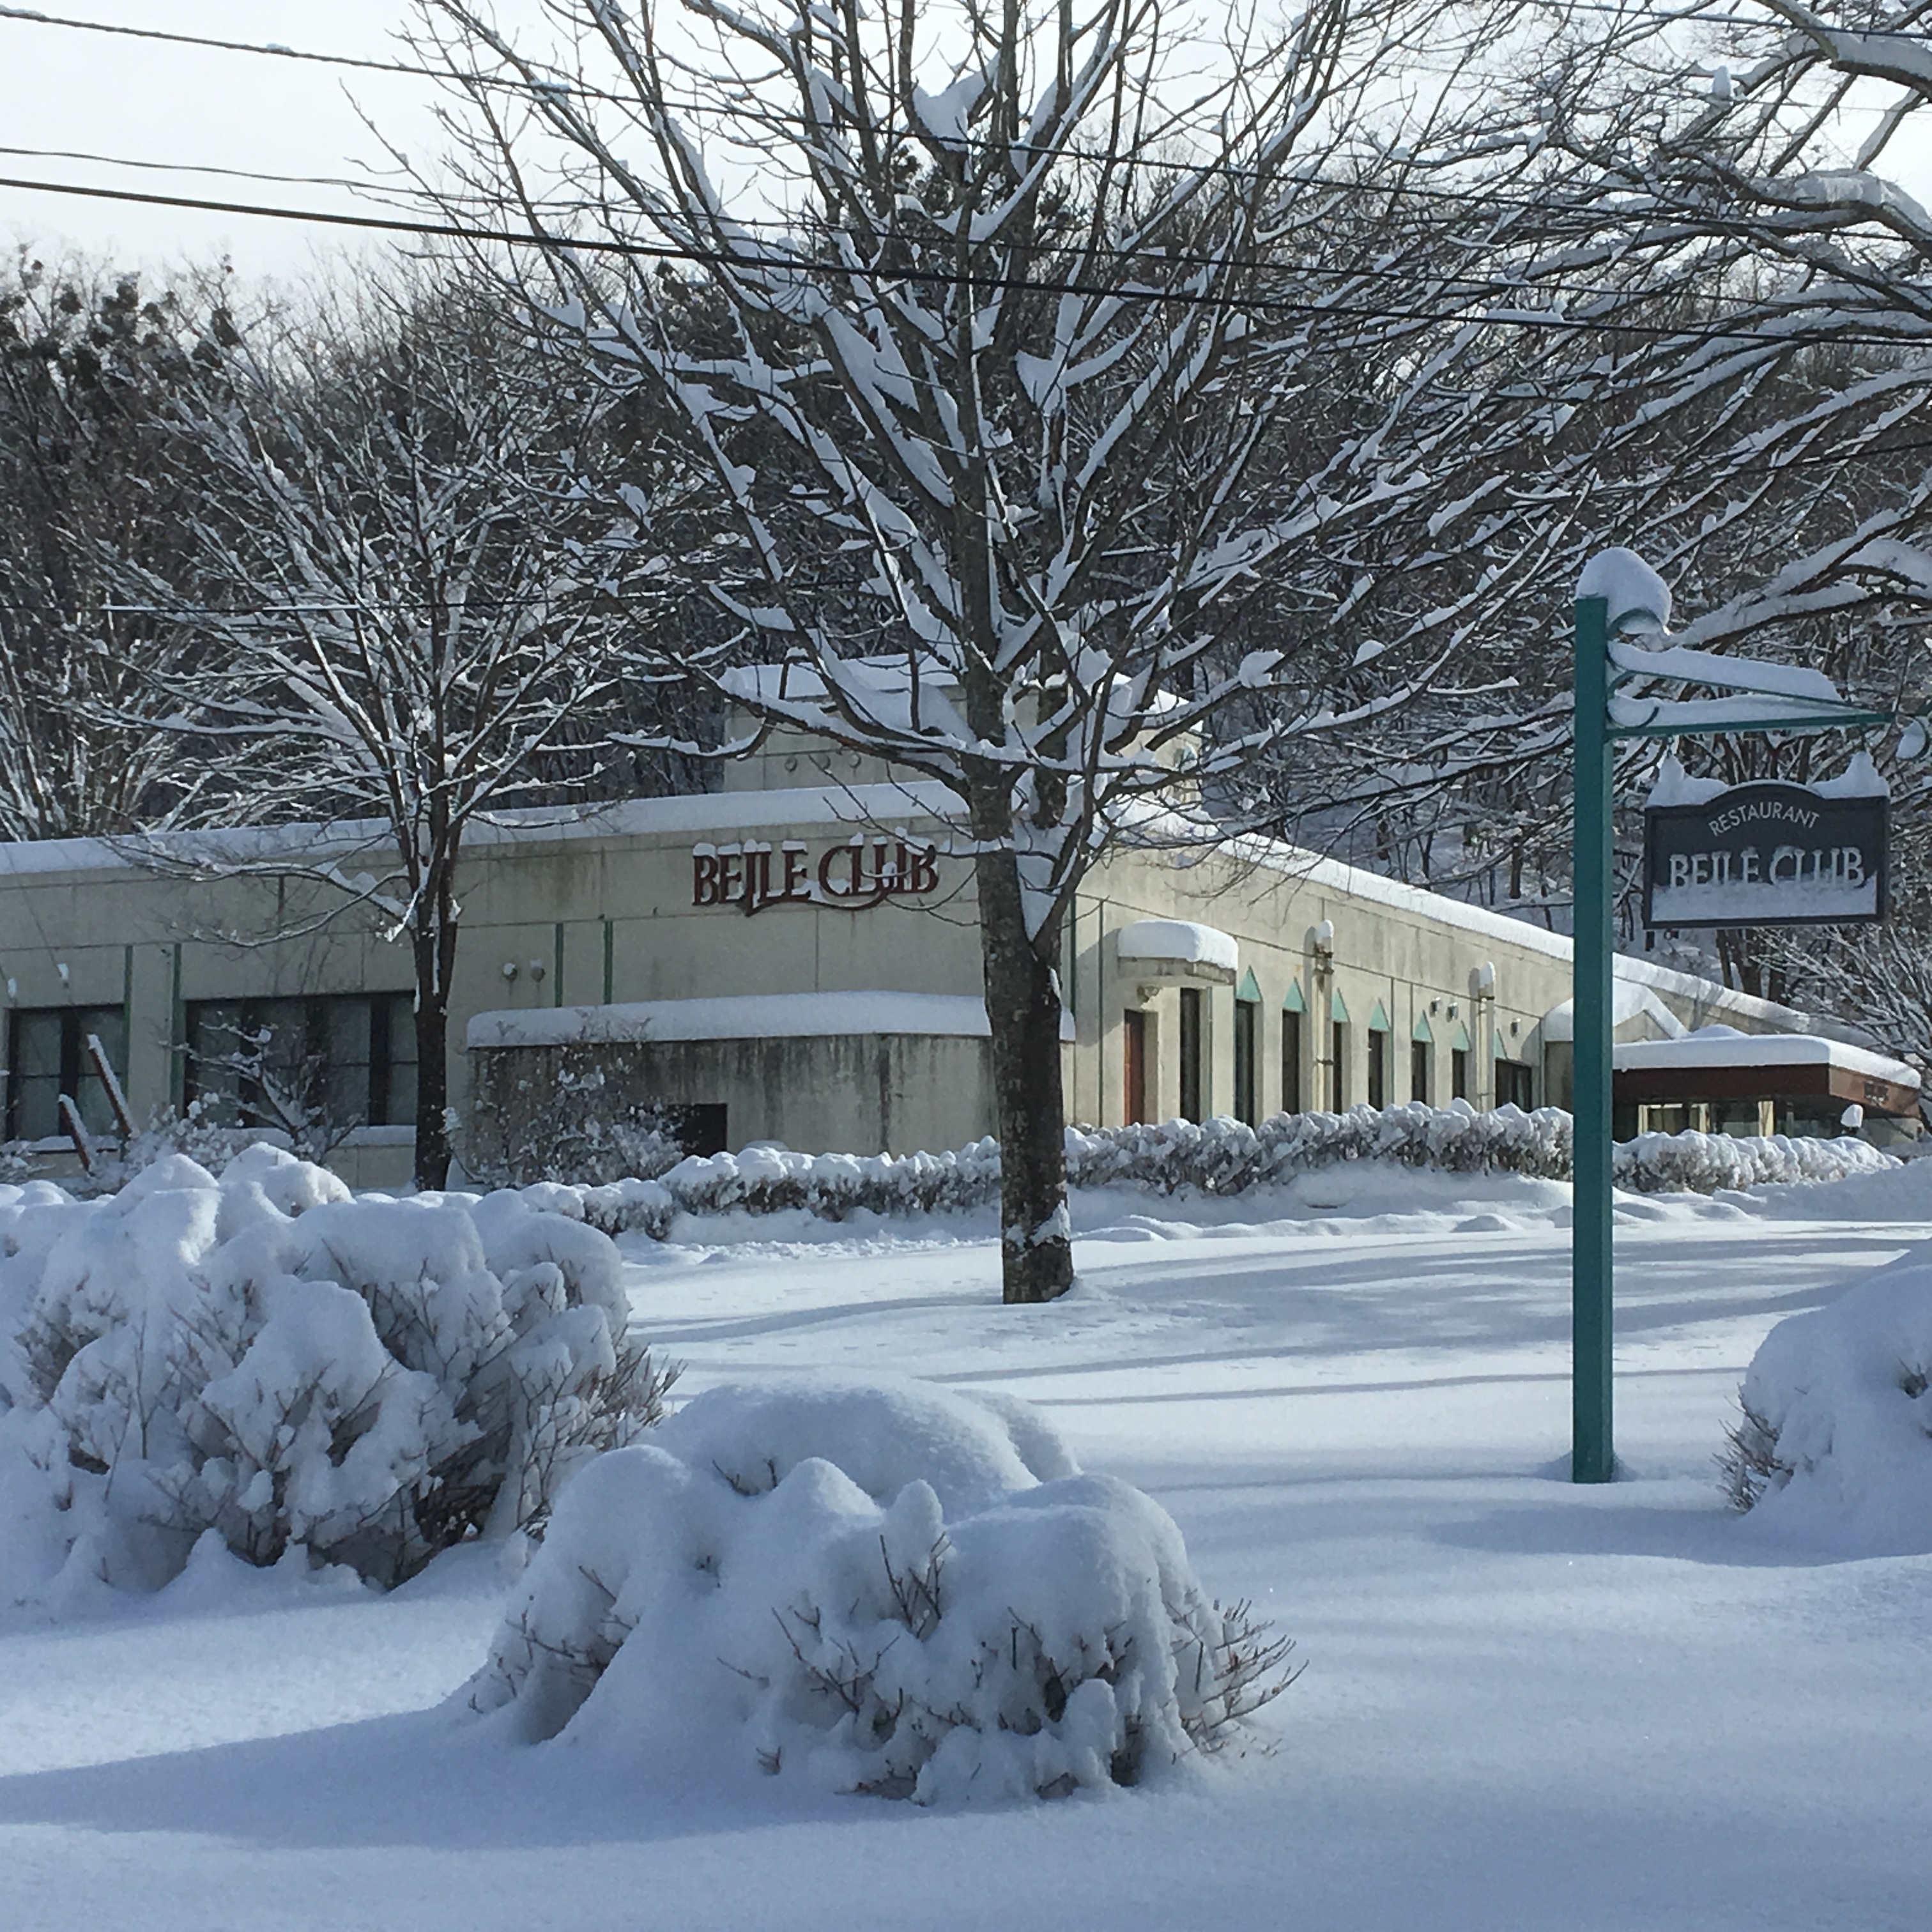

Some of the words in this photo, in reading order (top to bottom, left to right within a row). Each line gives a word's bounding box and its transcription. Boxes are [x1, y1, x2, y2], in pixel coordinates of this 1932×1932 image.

[1708, 801, 1820, 837] RESTAURANT
[692, 849, 812, 917] BELLE
[818, 842, 939, 896] CLUB
[1669, 847, 1761, 889] BELLE
[1768, 846, 1864, 890] CLUB
